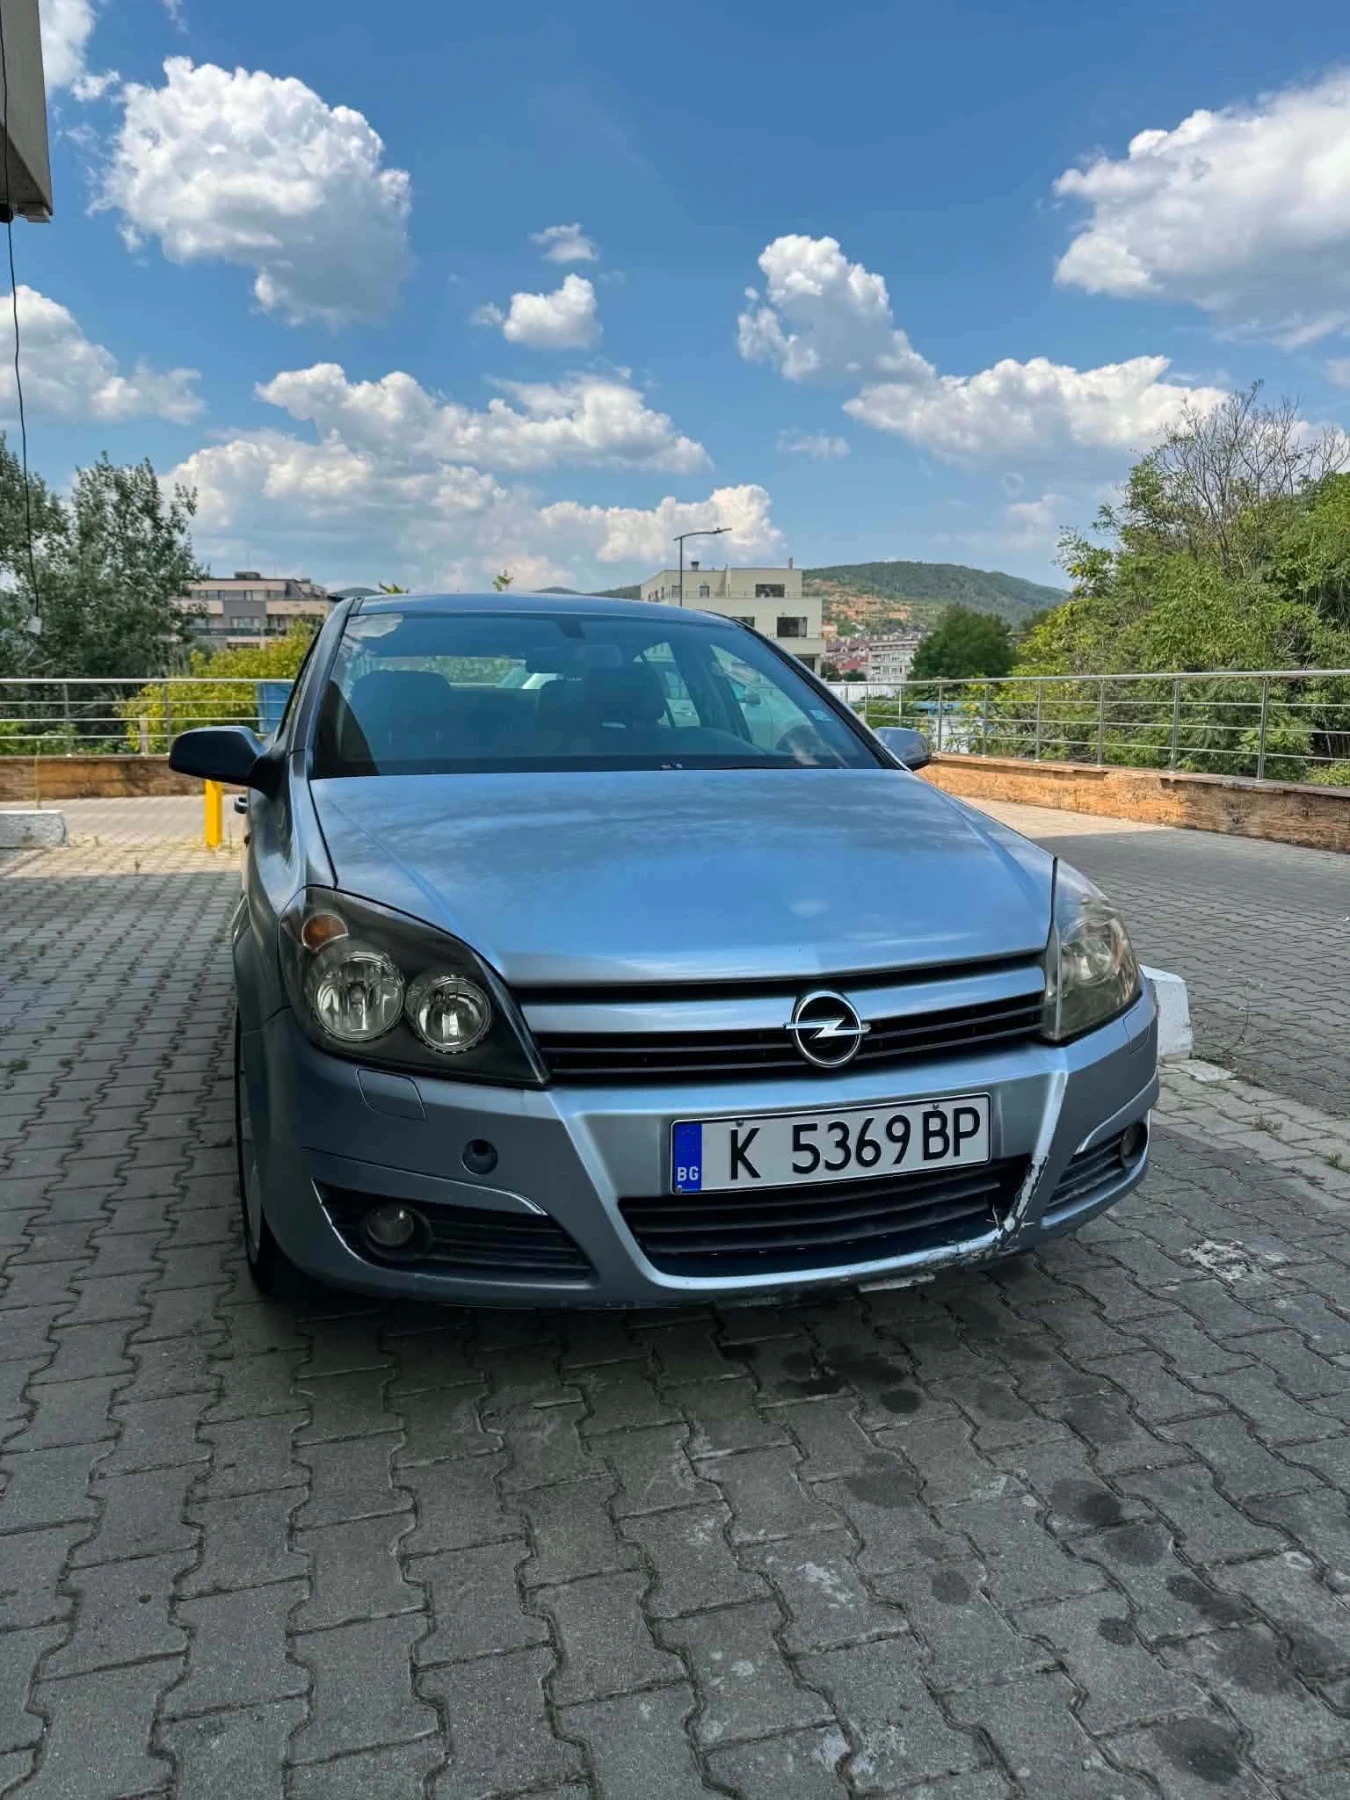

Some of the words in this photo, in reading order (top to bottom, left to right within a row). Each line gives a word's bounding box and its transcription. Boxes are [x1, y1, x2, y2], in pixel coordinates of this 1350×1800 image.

[730, 1128, 761, 1180] K
[792, 1115, 911, 1174] 5369
[922, 1107, 981, 1160] BP
[676, 1166, 699, 1182] BG
